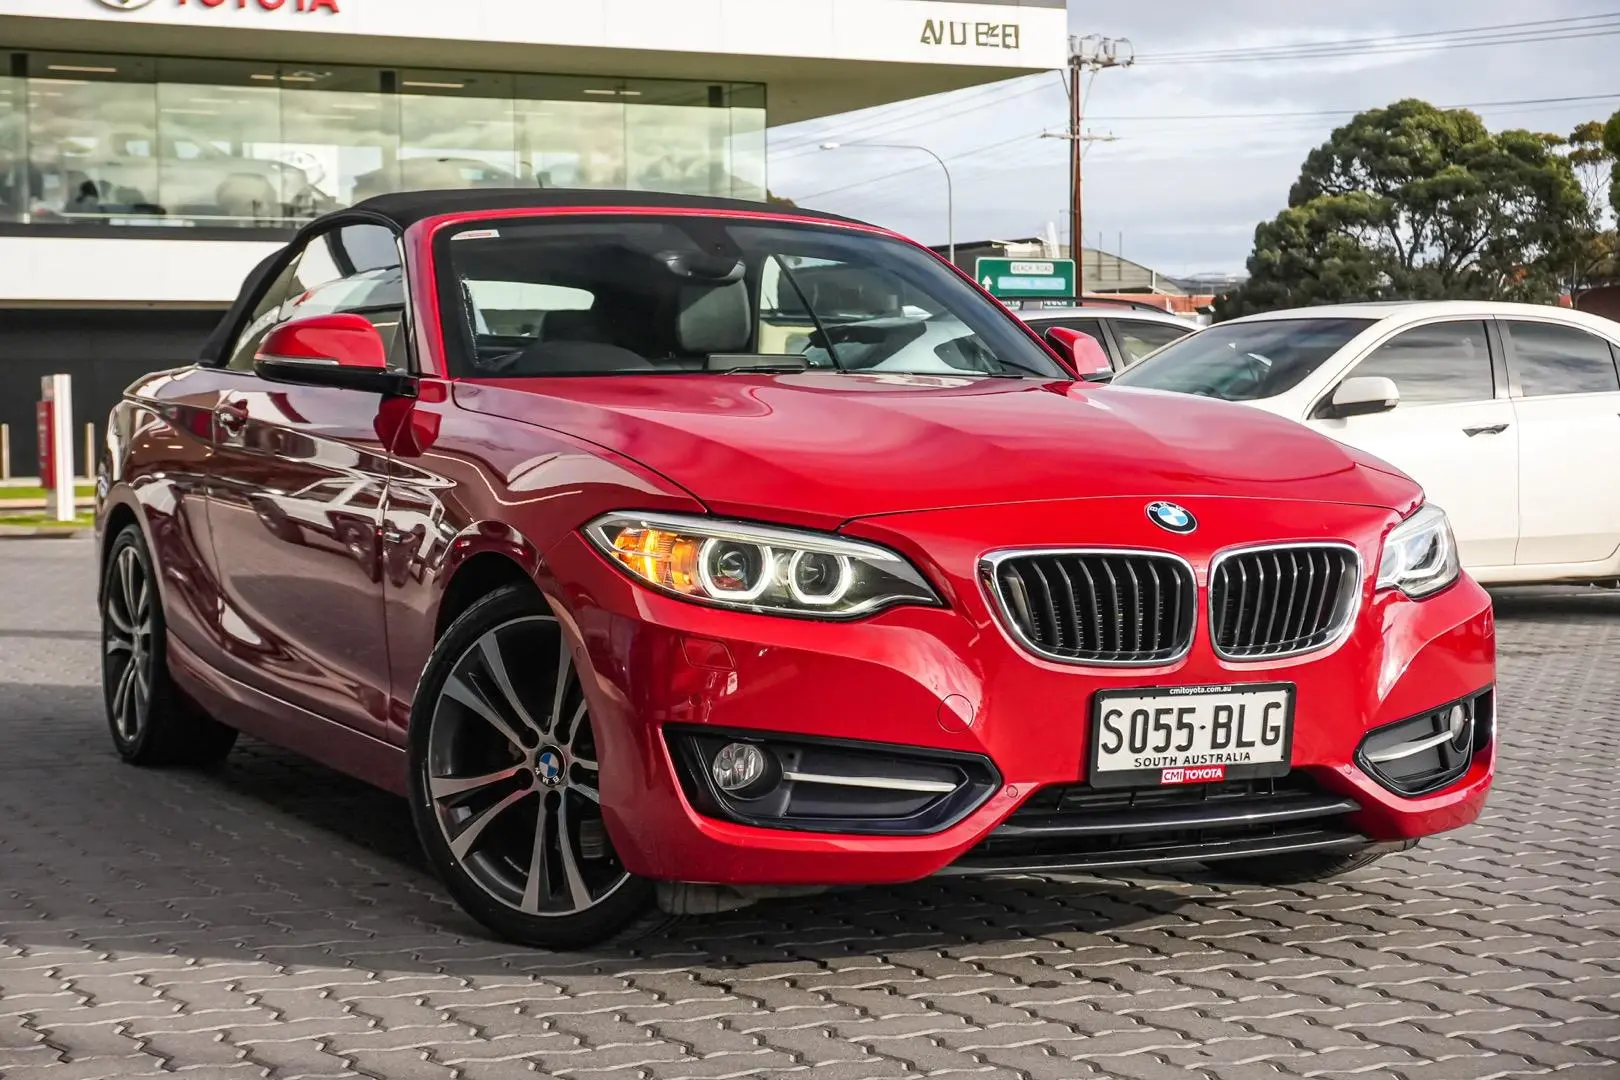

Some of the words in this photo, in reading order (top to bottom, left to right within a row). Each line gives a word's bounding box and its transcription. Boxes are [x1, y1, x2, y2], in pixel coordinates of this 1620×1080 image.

[1169, 685, 1232, 696] cmitoyota.com.au
[1134, 756, 1178, 768] SOUTH
[1183, 752, 1251, 765] AUSTRALIA
[1163, 770, 1183, 782] CMI
[1184, 768, 1223, 780] TOYOTA
